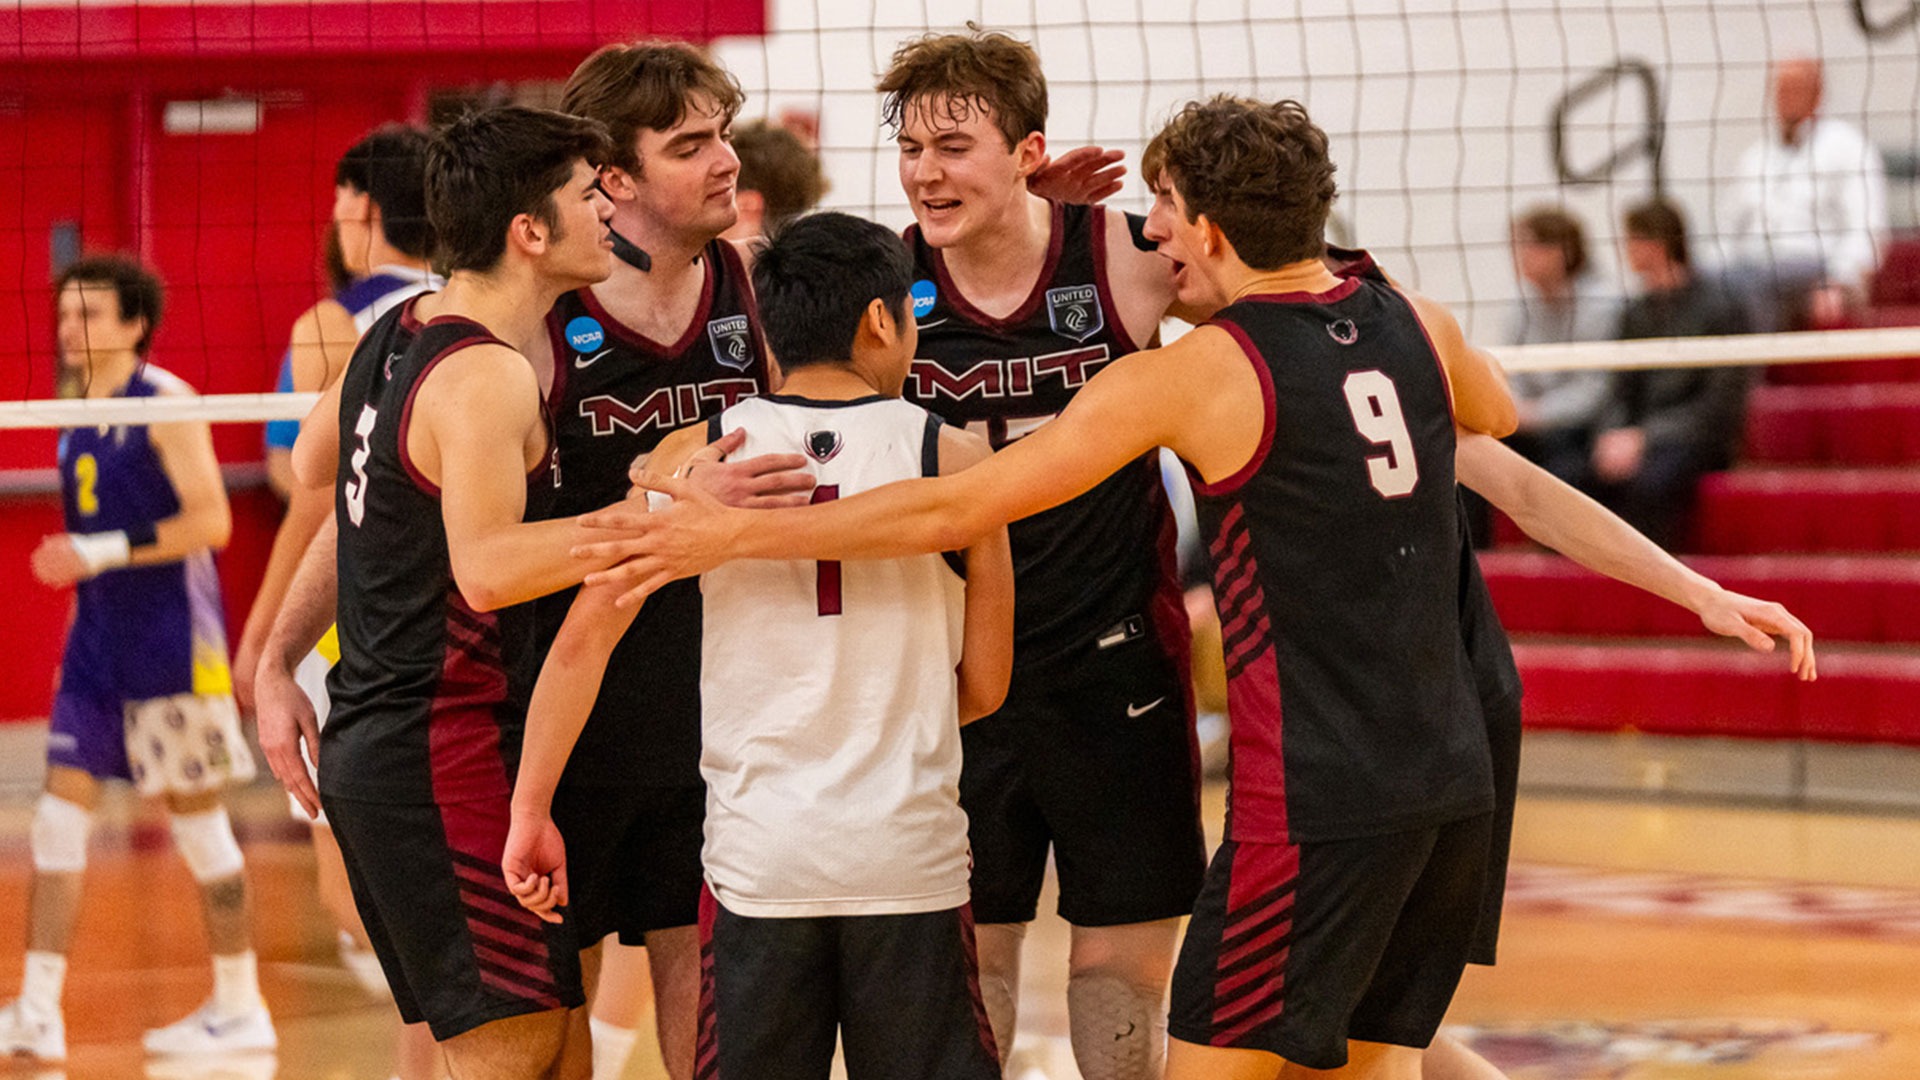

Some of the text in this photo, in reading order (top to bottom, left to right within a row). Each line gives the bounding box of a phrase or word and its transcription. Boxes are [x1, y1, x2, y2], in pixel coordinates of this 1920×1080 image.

[1052, 289, 1093, 303] UNITED
[572, 331, 603, 345] NCAA
[712, 320, 748, 334] UNITED
[908, 343, 1110, 401] MIT
[579, 378, 759, 436] MIT
[1342, 369, 1420, 500] 9
[74, 452, 99, 516] 2
[344, 403, 378, 529] 3
